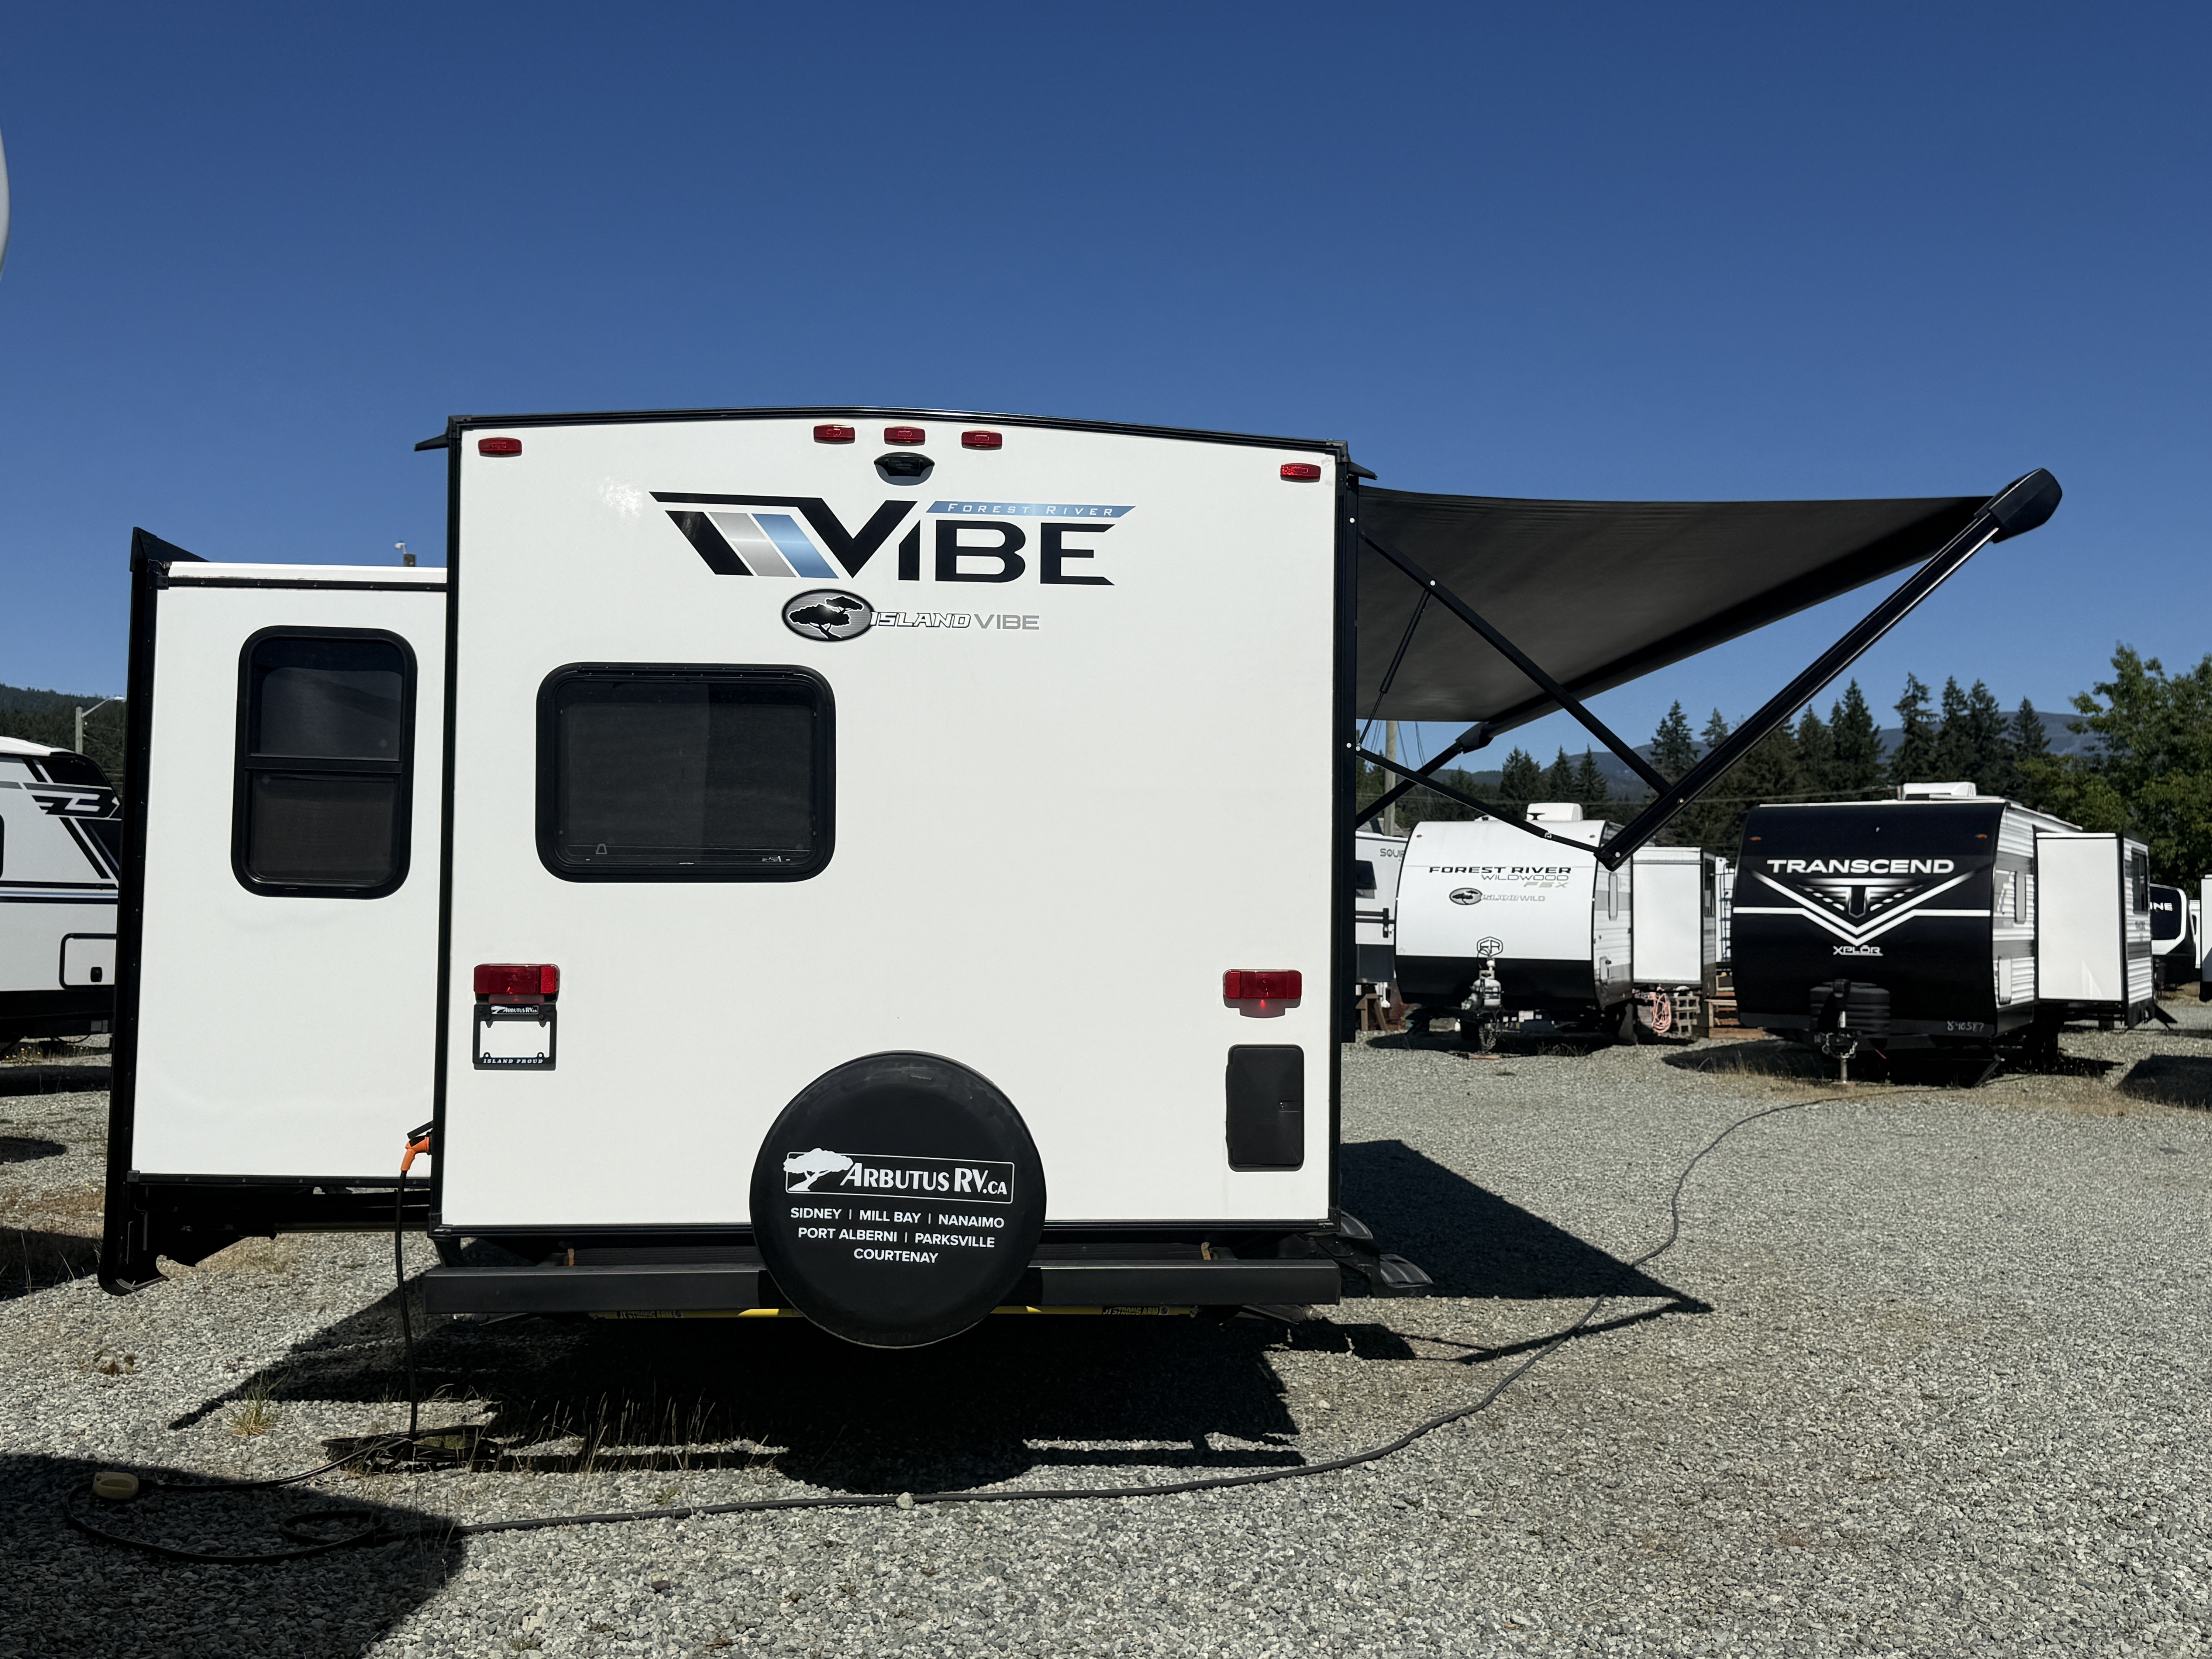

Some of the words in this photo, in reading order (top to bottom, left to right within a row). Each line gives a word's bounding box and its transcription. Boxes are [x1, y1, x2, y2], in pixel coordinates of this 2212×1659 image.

[947, 503, 1030, 516] FOREST
[1045, 504, 1114, 517] RIVER
[796, 500, 1116, 586] VIBE
[869, 611, 971, 629] ISLAND
[973, 614, 1040, 631] VIBE
[1767, 859, 1954, 874] TRANSCEND
[840, 1163, 950, 1192] ARBUTUS
[790, 1207, 842, 1219] SIDNEY
[859, 1210, 891, 1223] MILL
[893, 1212, 922, 1224] BAY
[938, 1215, 1005, 1229] NANAIMO
[798, 1227, 836, 1239] PORT
[839, 1229, 897, 1242] ALBERNI
[915, 1233, 995, 1248] PARKSVILLE
[854, 1248, 939, 1264] COURTENAY
